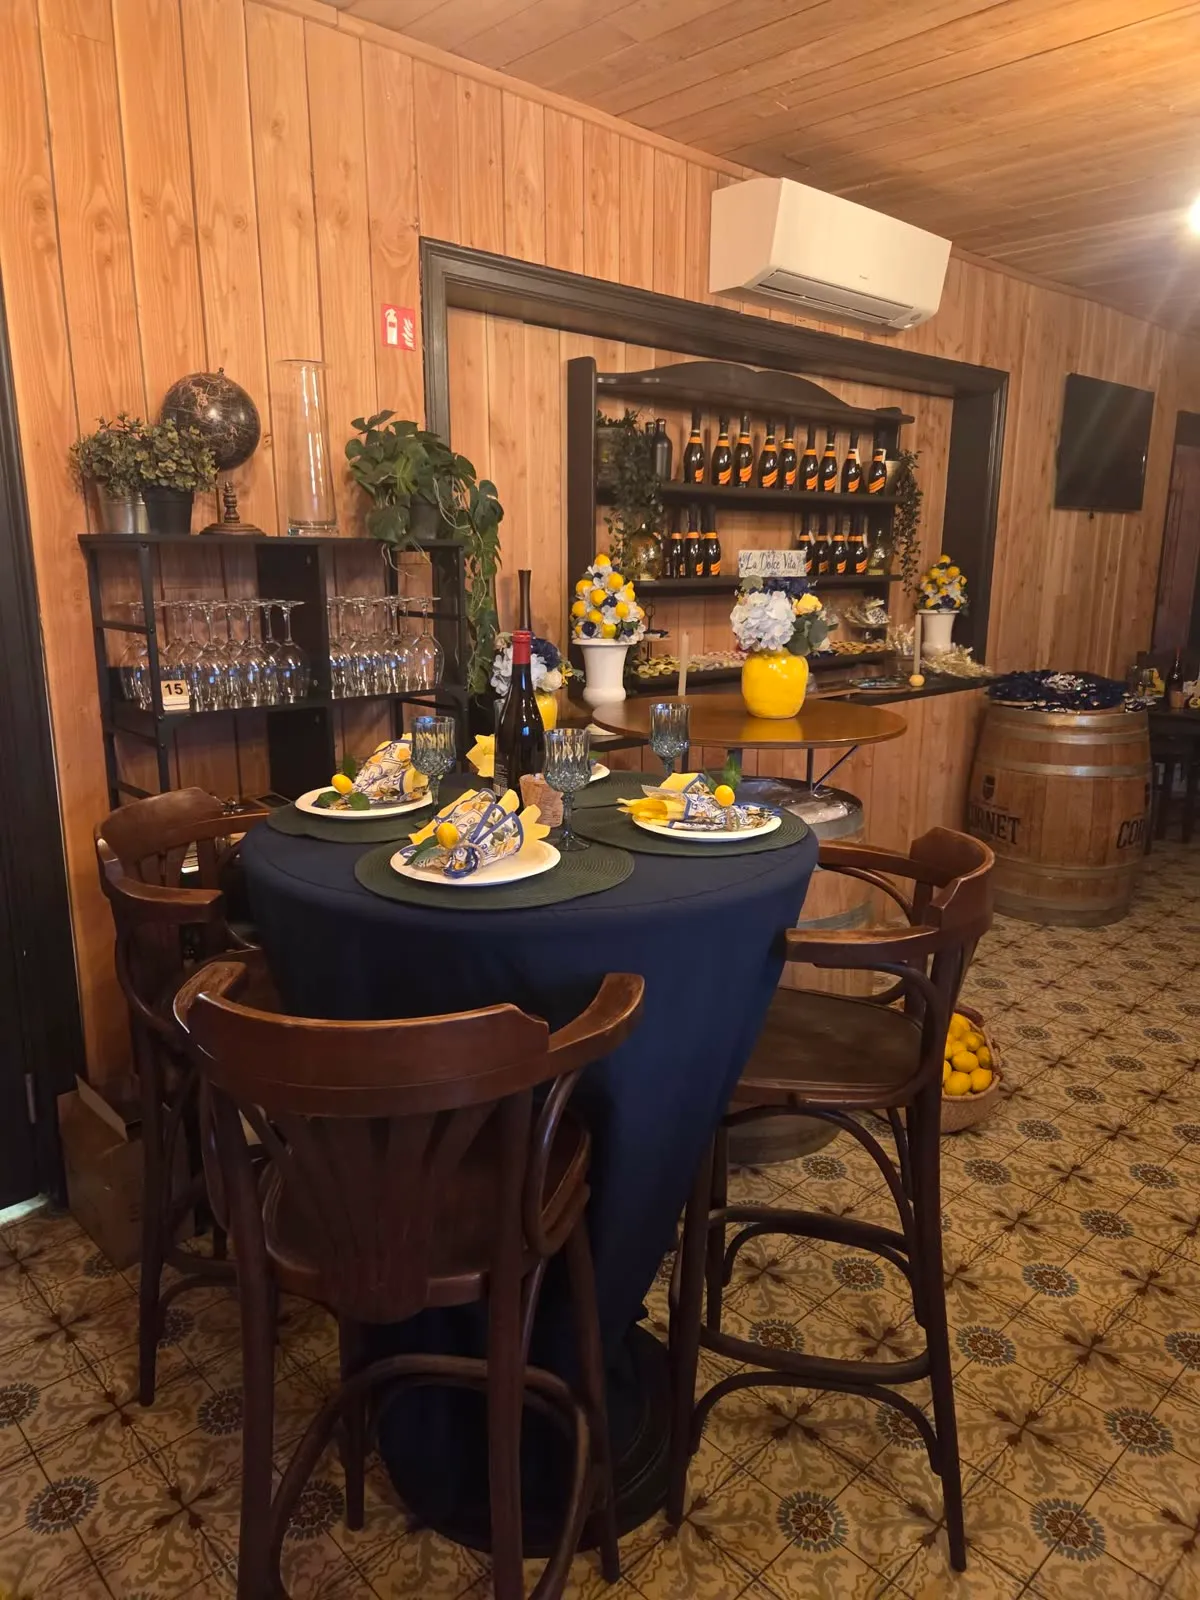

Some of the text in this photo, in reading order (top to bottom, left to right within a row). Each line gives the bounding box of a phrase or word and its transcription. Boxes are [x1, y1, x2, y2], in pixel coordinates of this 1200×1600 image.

[745, 552, 796, 571] La Dolce Vita
[165, 683, 184, 696] 15
[966, 804, 1021, 845] ORNET
